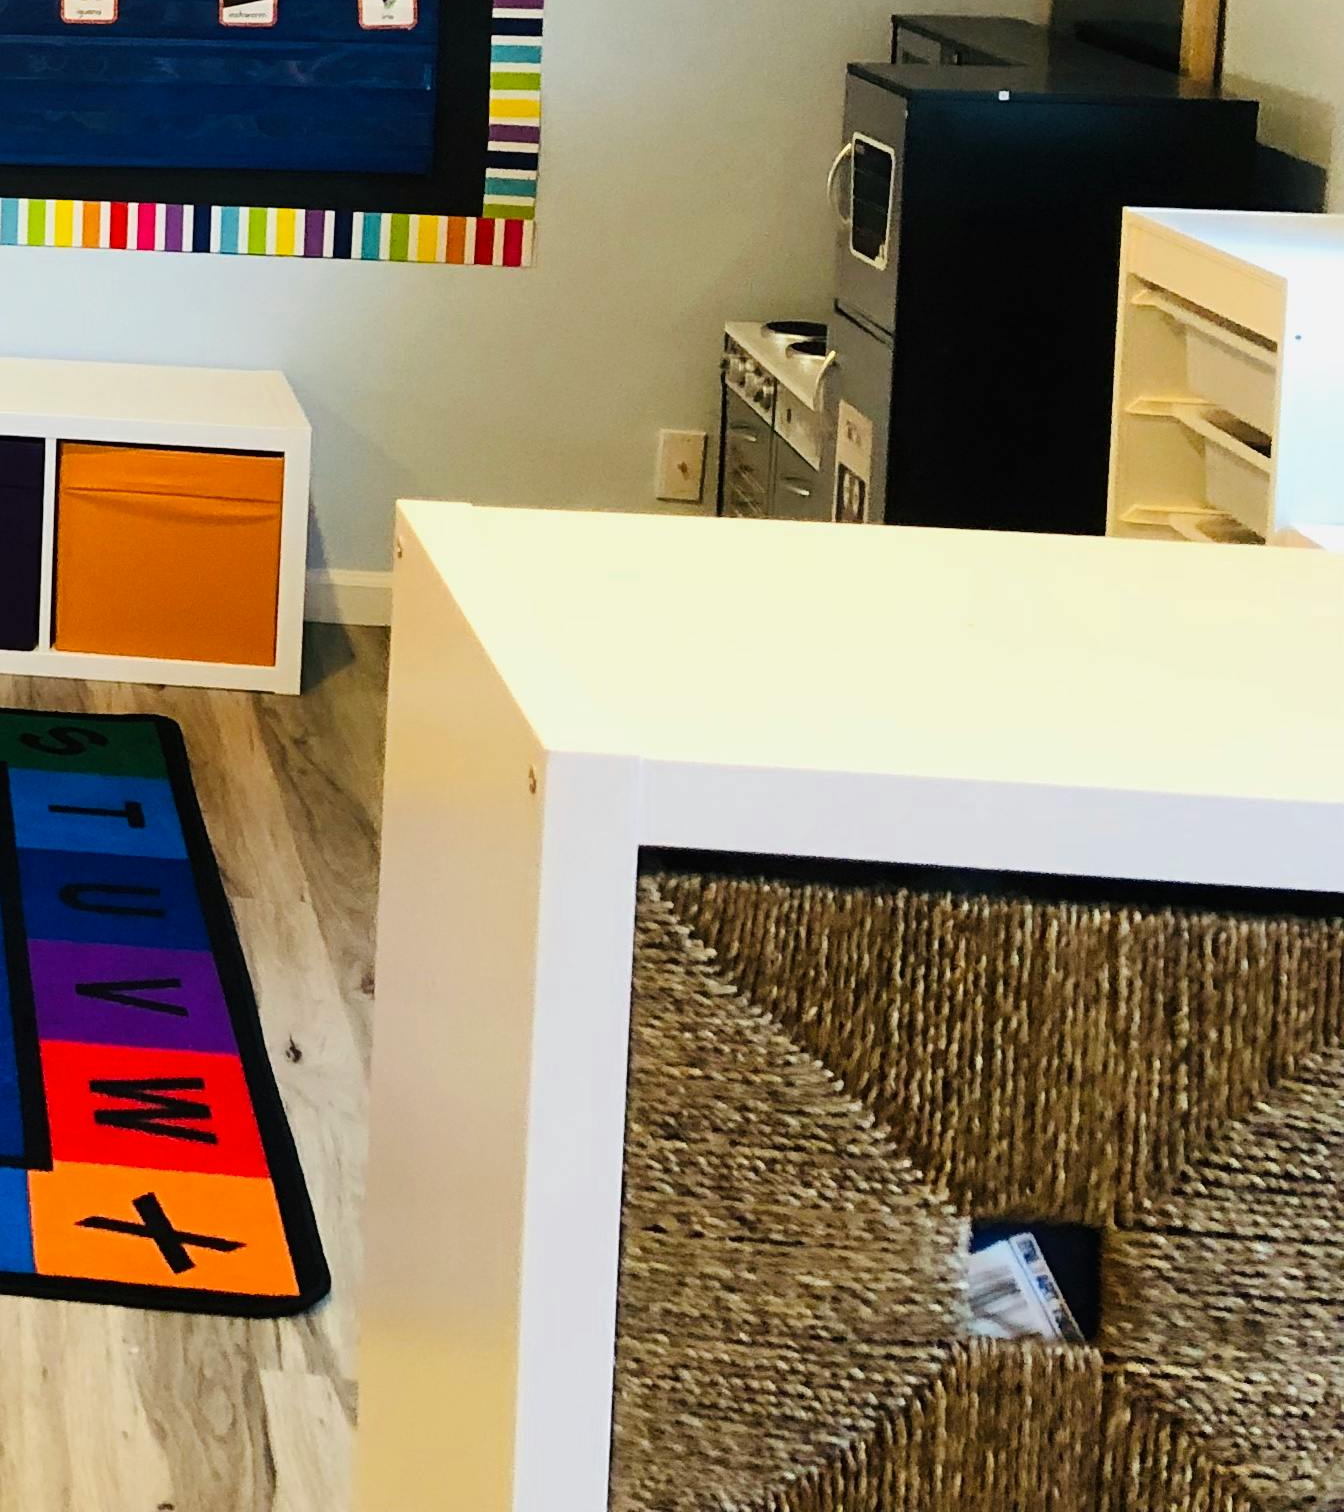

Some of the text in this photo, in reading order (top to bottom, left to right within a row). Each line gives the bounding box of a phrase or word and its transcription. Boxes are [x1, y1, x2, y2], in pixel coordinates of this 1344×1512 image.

[19, 726, 247, 1274] S T U V W X
